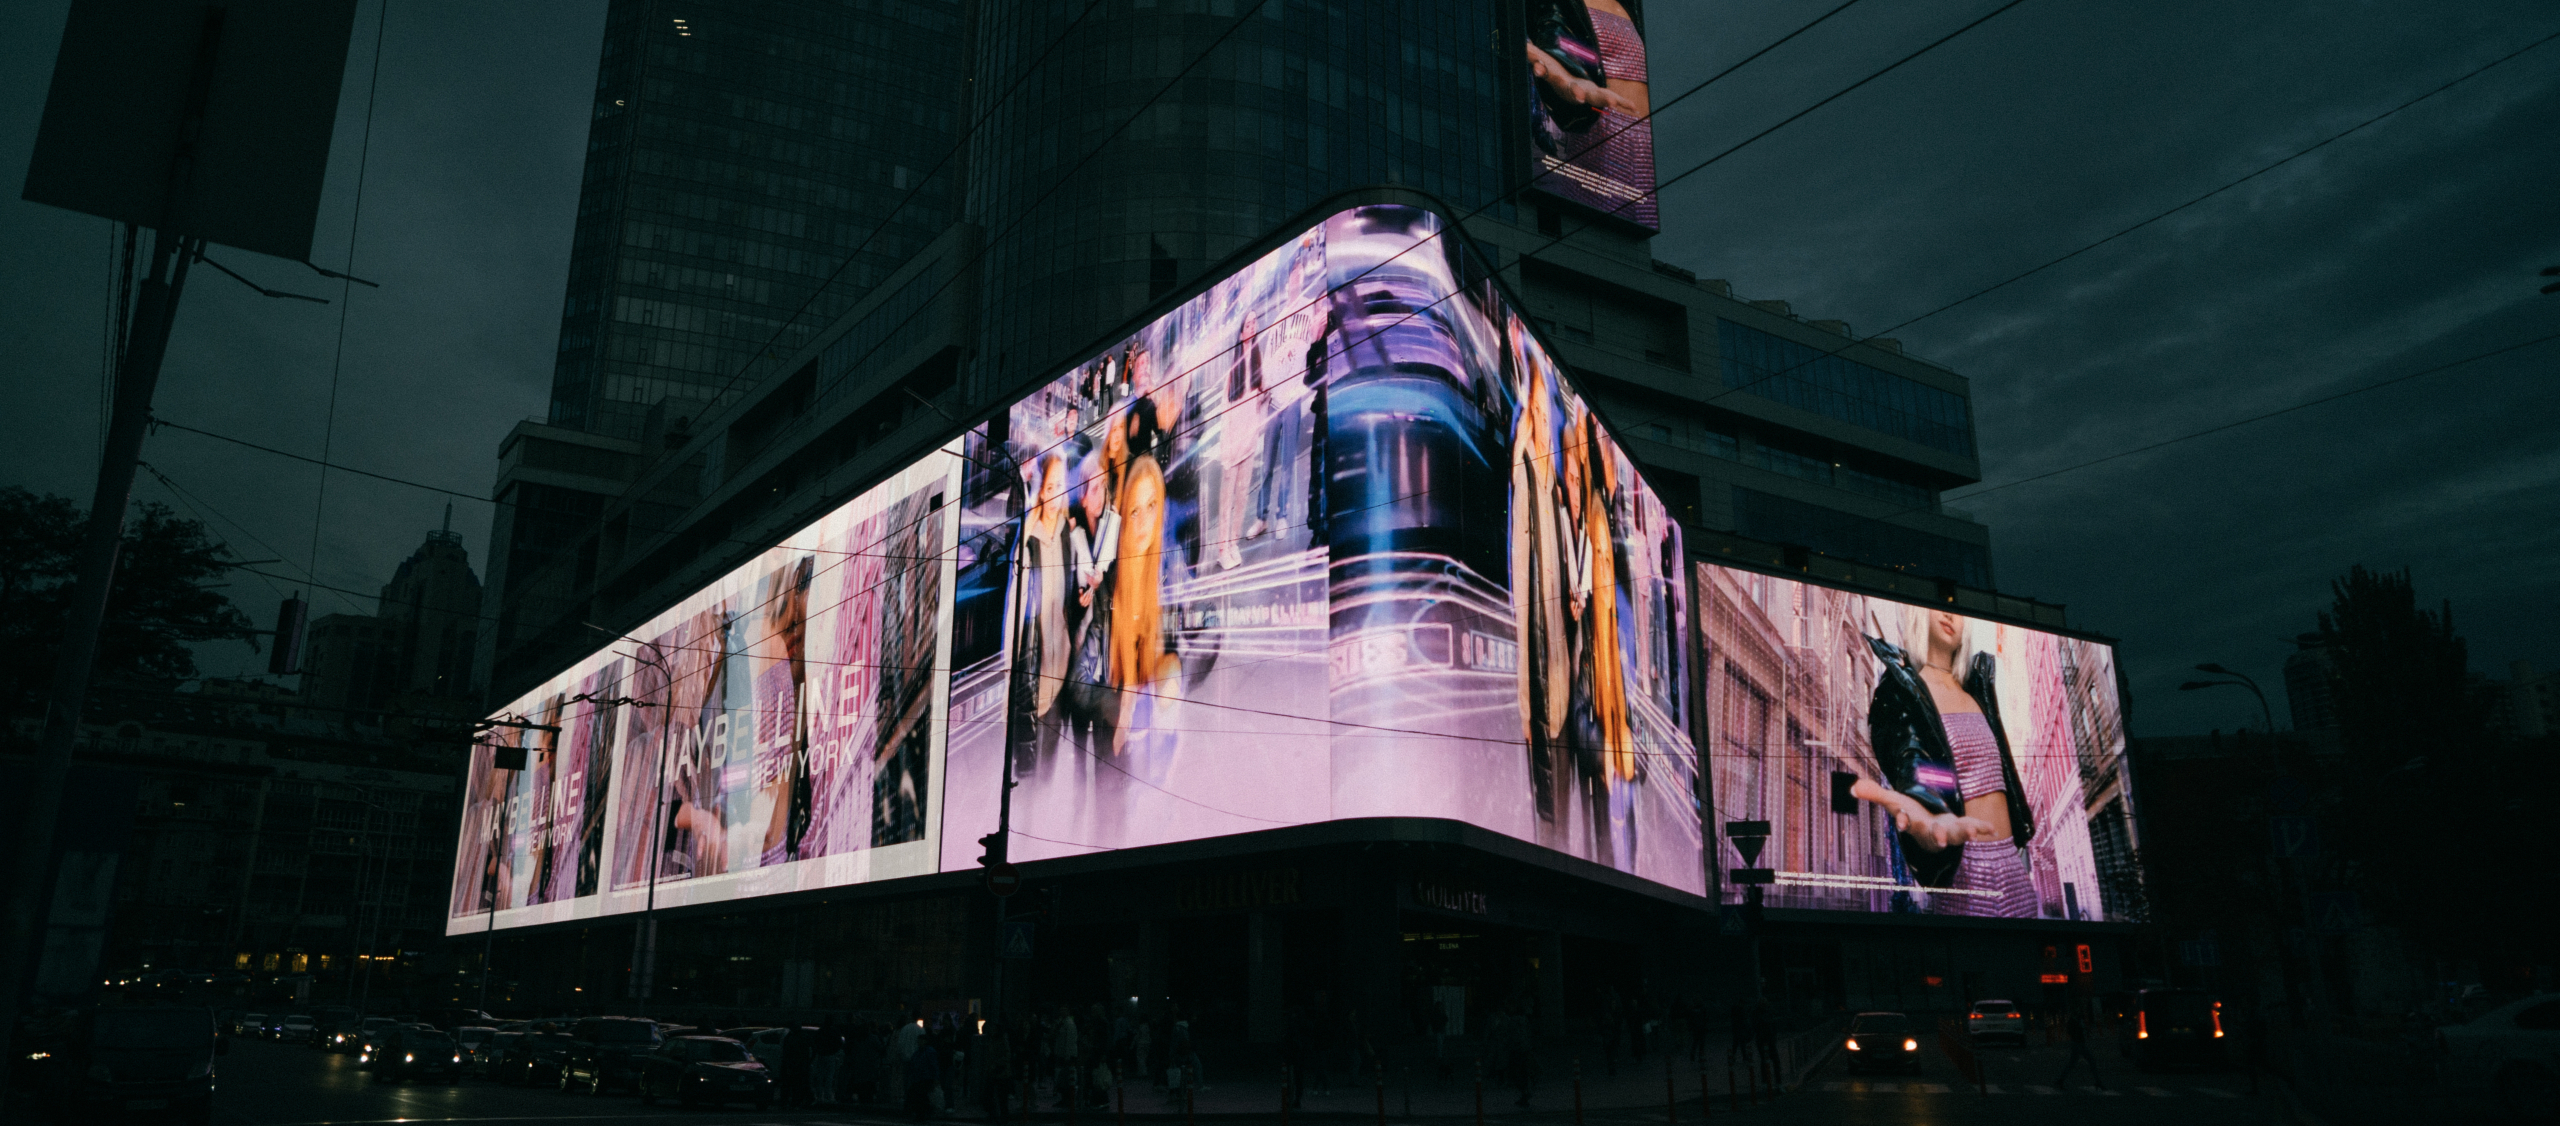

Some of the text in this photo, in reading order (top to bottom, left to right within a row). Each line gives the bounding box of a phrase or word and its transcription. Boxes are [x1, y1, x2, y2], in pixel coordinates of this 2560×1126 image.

[655, 660, 863, 788] MAYBELLINE
[797, 733, 854, 779] YORK
[479, 771, 583, 845] MAYBELLINE
[548, 820, 576, 848] YORK
[1175, 866, 1300, 912] GULLIVER
